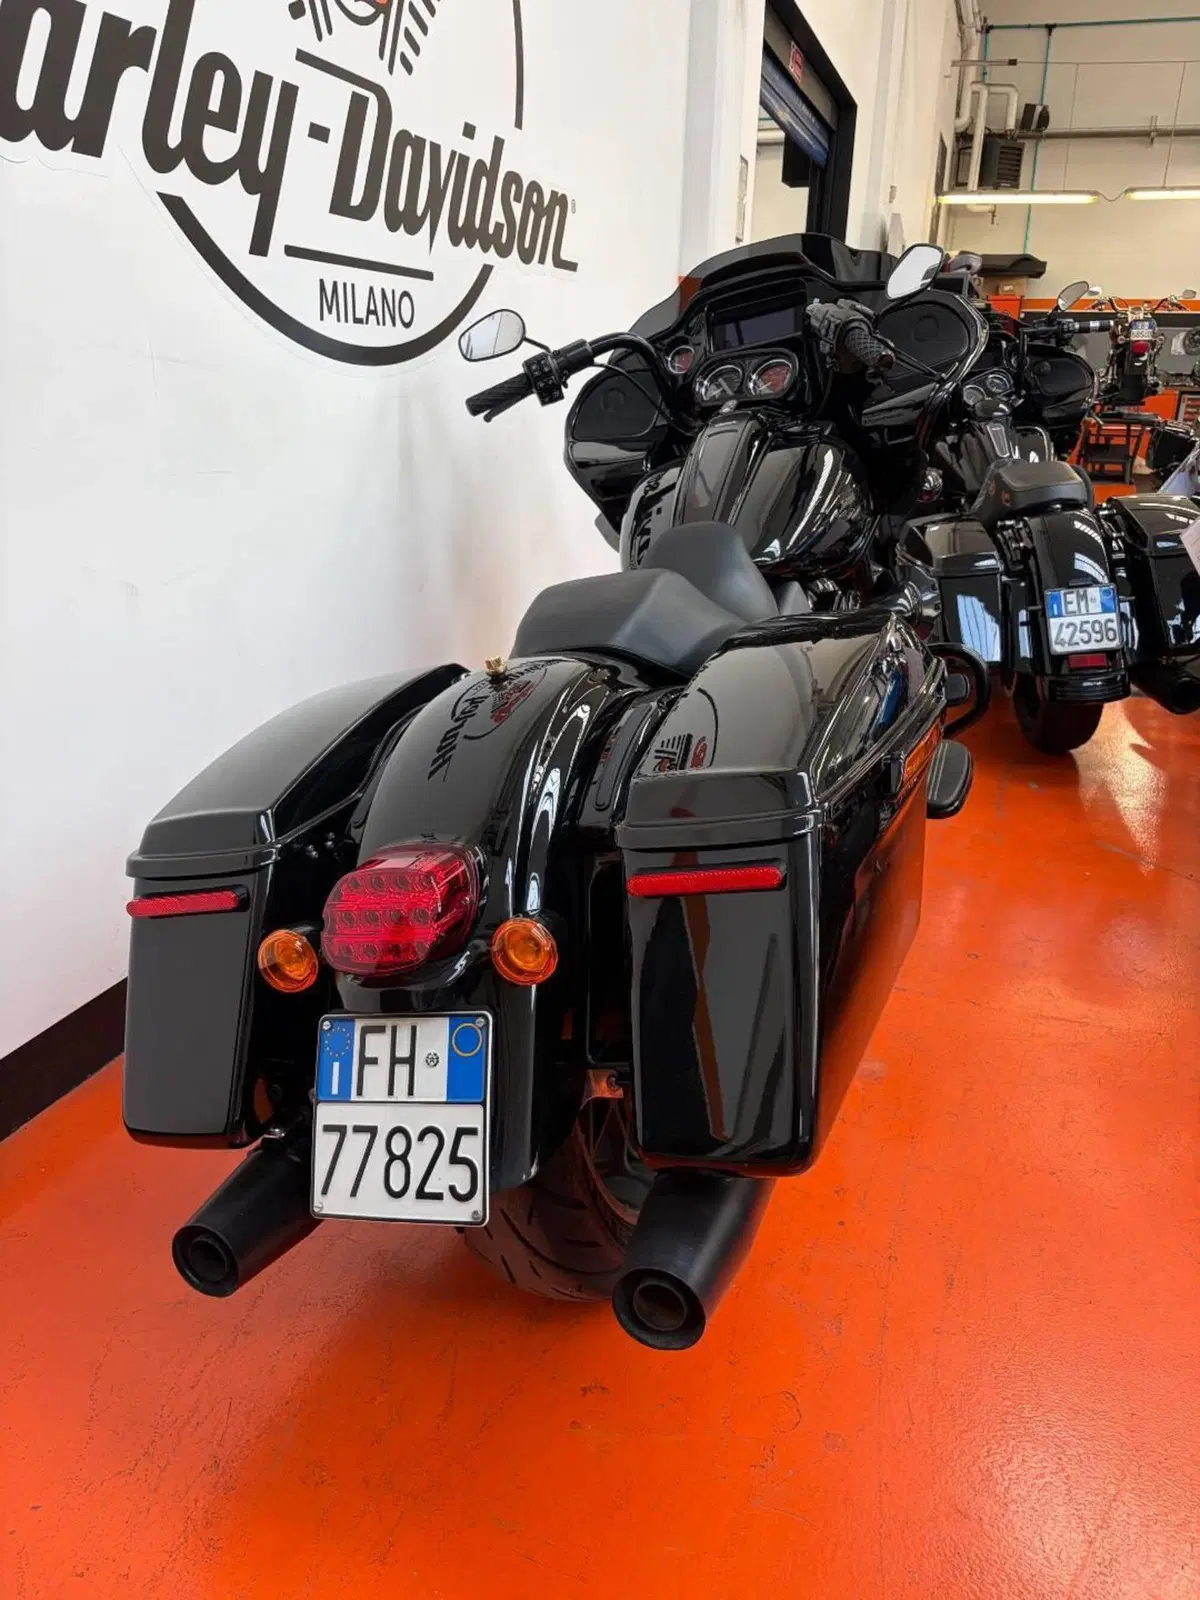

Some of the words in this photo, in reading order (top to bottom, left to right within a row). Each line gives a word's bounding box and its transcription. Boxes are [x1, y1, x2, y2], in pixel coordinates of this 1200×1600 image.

[0, 0, 578, 272] arley-Davidson
[318, 278, 416, 329] MILANO
[1054, 618, 1117, 647] 42596
[1063, 589, 1090, 615] EM
[331, 1061, 340, 1096] I
[356, 1024, 417, 1097] FH
[320, 1124, 479, 1203] 77825
